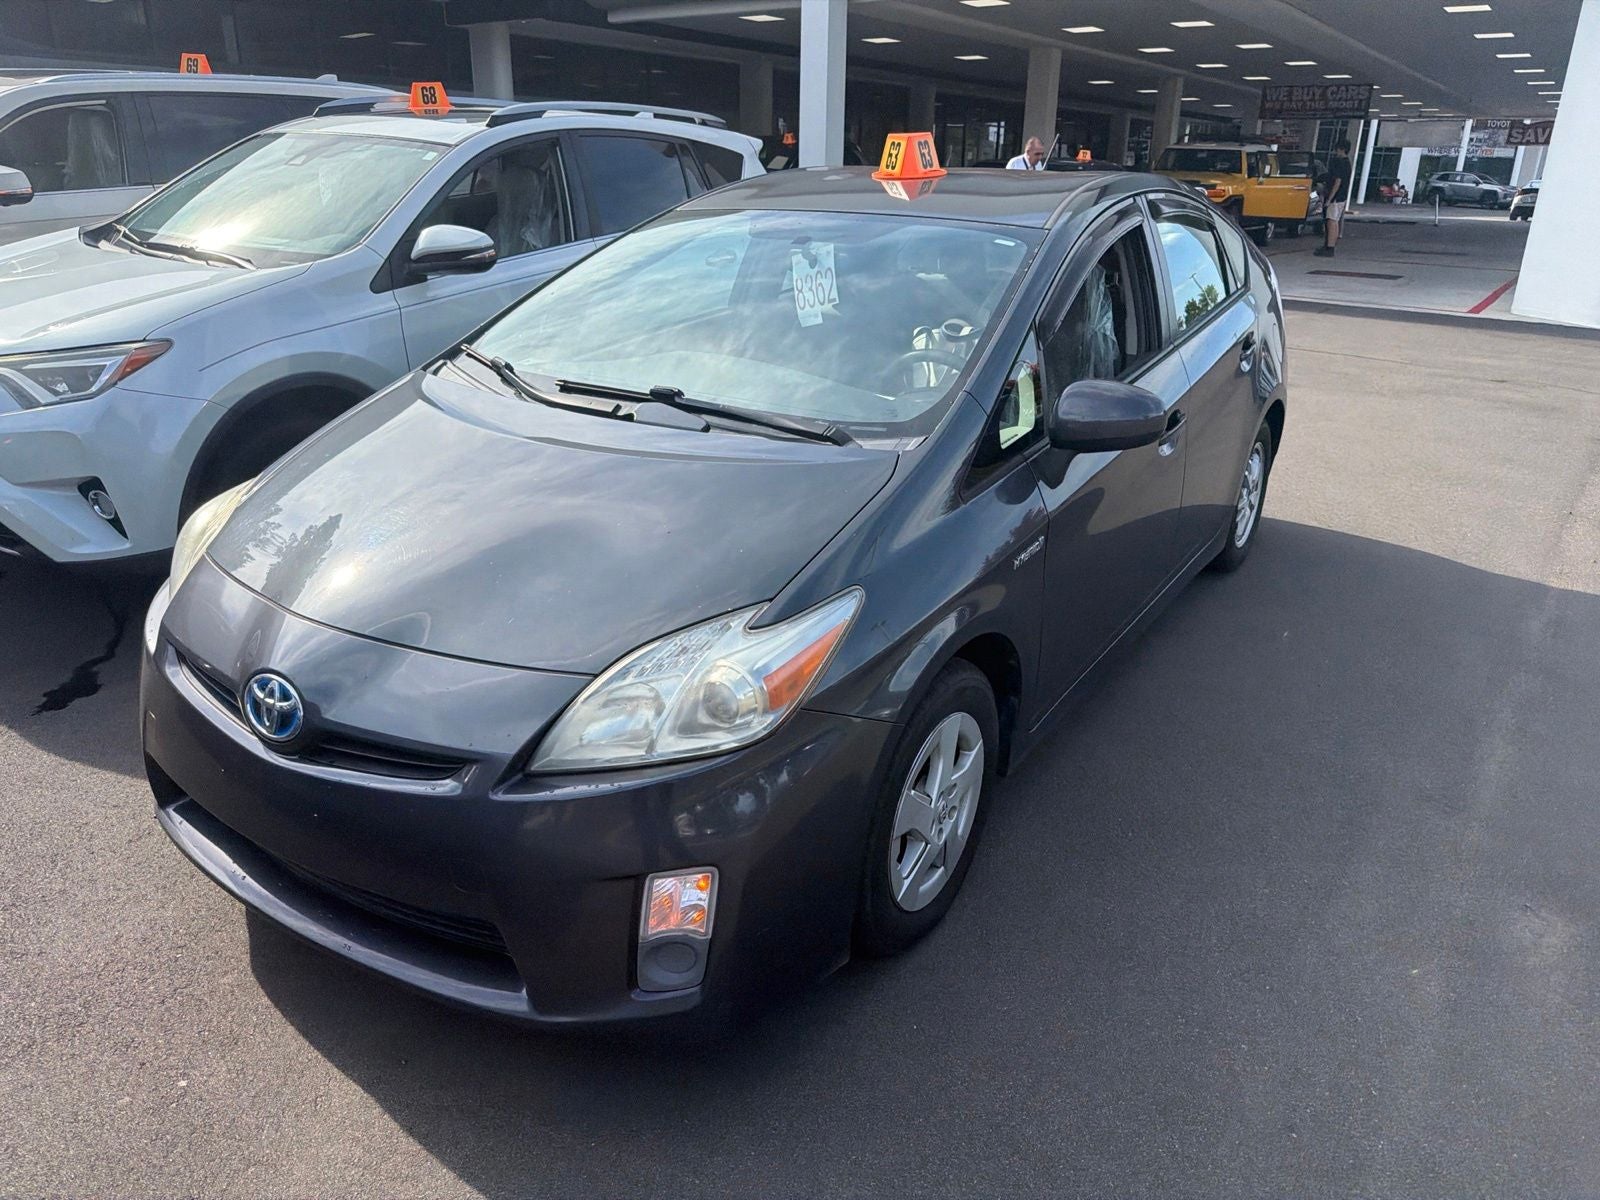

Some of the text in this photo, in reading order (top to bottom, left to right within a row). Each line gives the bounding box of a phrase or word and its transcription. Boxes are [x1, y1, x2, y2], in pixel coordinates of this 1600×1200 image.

[186, 57, 199, 74] 69
[420, 86, 438, 105] 68
[1265, 86, 1370, 101] WE BUY CARS
[885, 141, 902, 170] 63
[917, 140, 934, 170] 63
[796, 268, 837, 310] 8362
